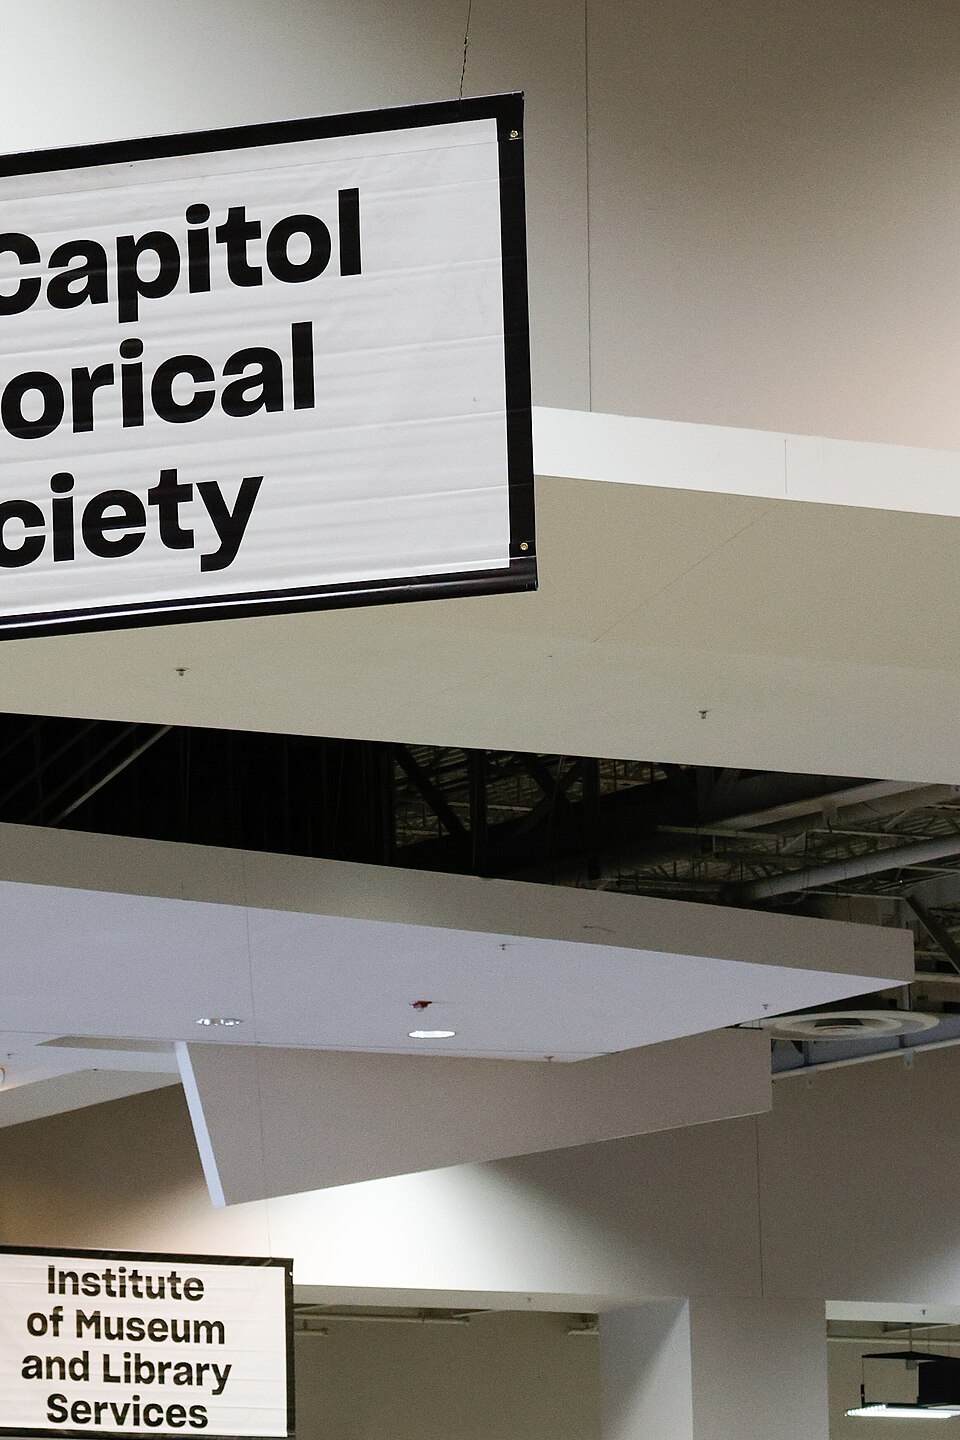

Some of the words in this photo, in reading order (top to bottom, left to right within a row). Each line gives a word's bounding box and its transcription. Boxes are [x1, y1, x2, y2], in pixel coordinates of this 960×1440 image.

[47, 1265, 204, 1301] Institute
[26, 1306, 63, 1337] of
[75, 1309, 226, 1344] Museum
[21, 1350, 89, 1381] and
[102, 1352, 232, 1395] Library
[46, 1393, 209, 1429] Services
